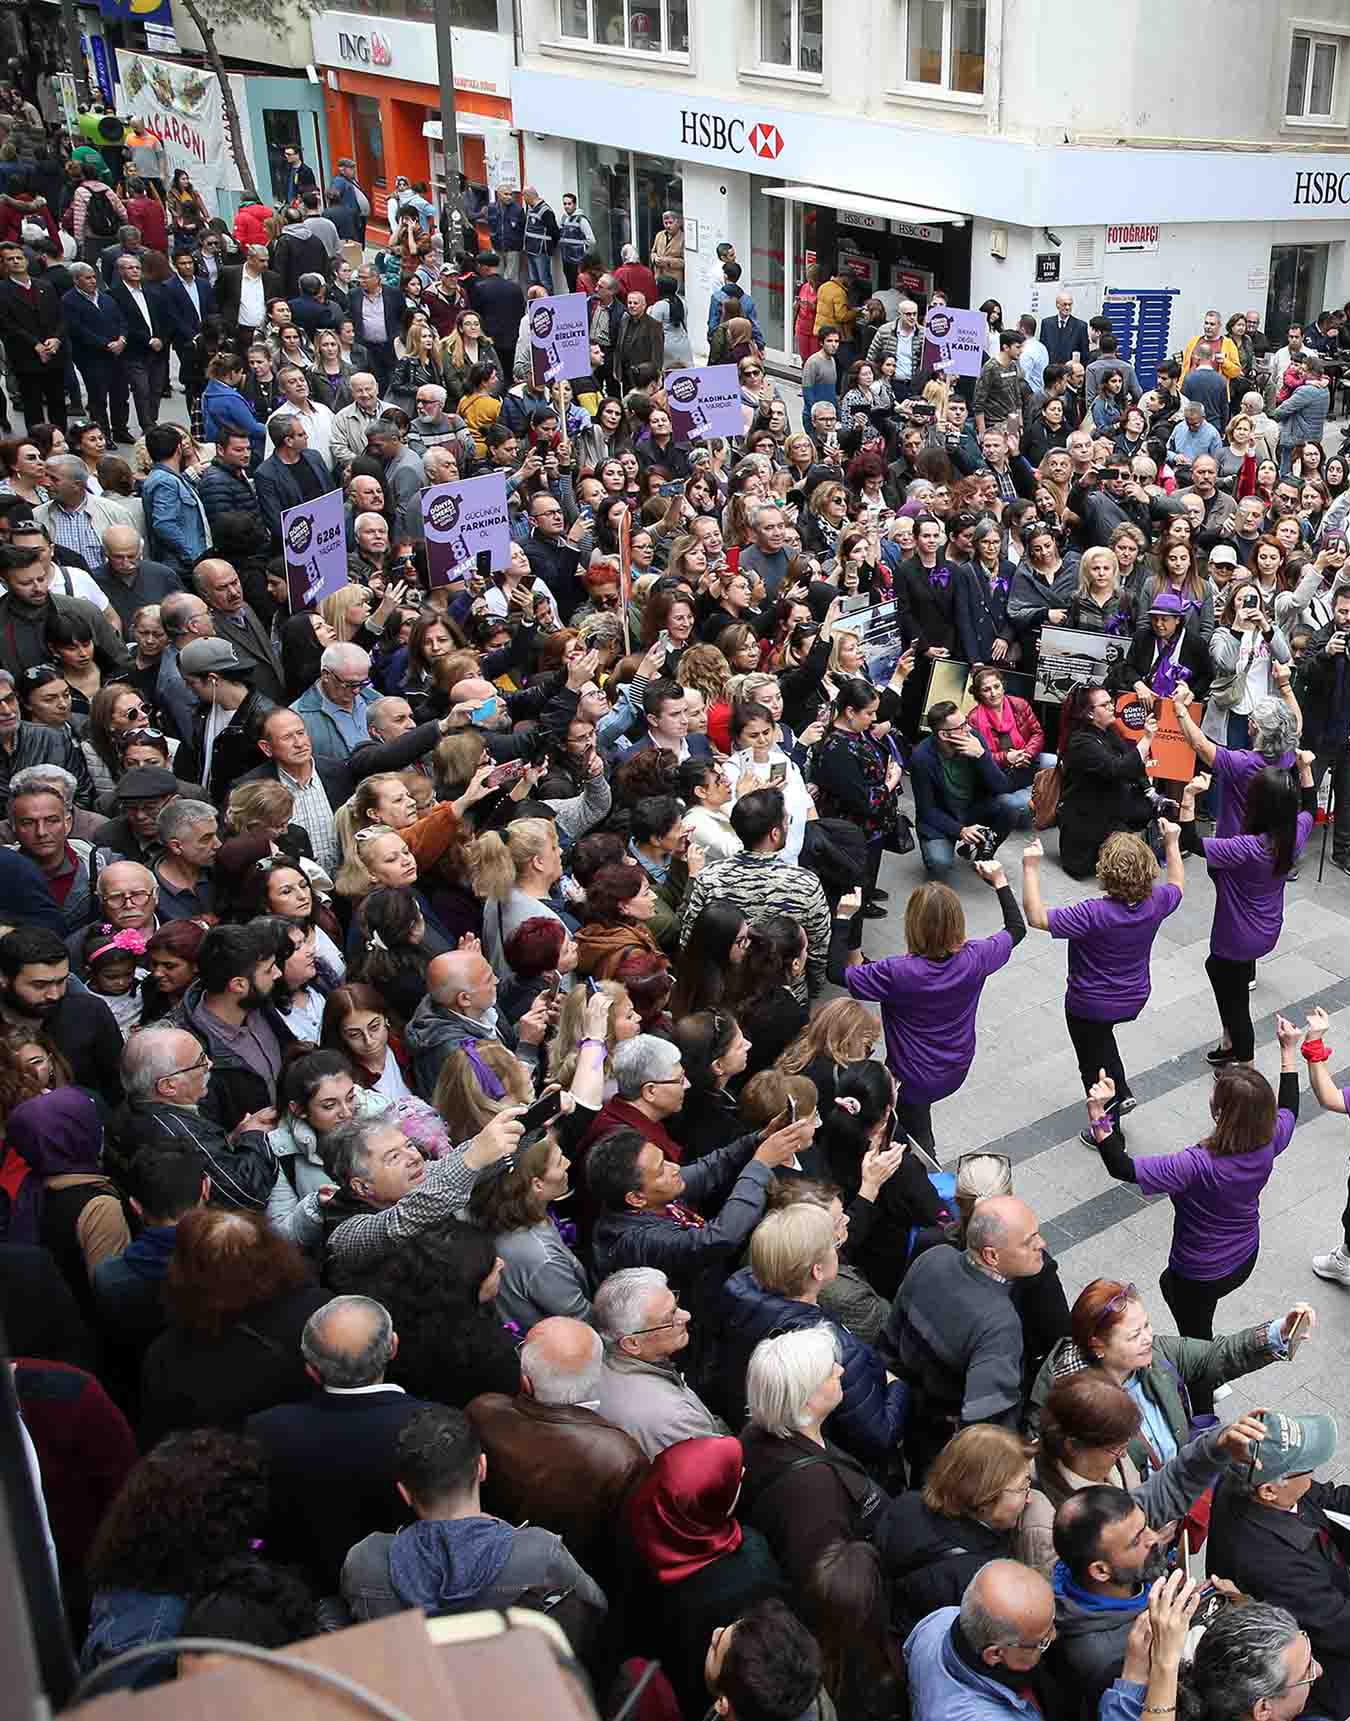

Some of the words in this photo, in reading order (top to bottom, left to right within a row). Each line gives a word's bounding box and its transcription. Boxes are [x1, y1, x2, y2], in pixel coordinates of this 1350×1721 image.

[338, 32, 370, 64] ING
[680, 110, 745, 154] HSBC
[547, 348, 559, 364] 8
[940, 347, 950, 360] 8
[951, 343, 980, 352] KADIN
[698, 393, 738, 403] KADINLAR
[691, 410, 705, 425] 8
[430, 498, 453, 514] DÜNYA
[432, 505, 455, 520] EMEKÇİ
[289, 519, 307, 537] DÜNYA
[460, 515, 507, 533] FARKINDA
[317, 523, 341, 545] 6284
[451, 540, 466, 560] 8
[306, 560, 318, 583] 8
[306, 576, 325, 600] MART
[1124, 712, 1145, 720] EMEKÇ
